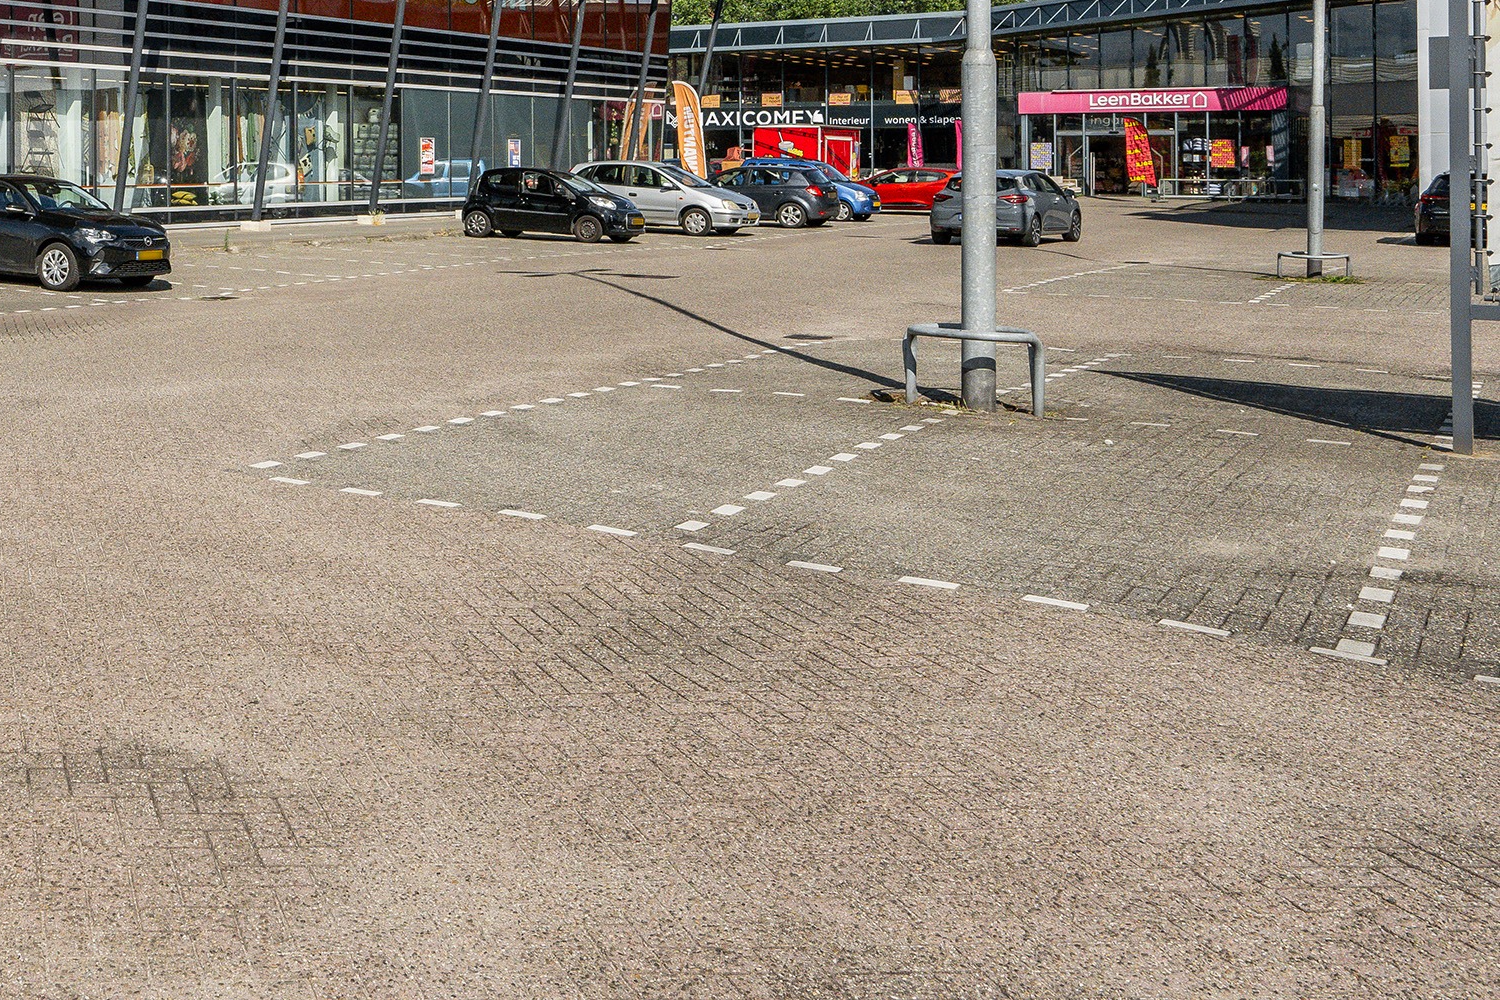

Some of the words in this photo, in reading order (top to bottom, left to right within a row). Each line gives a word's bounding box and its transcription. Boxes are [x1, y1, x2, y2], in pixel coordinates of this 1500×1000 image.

[1089, 93, 1191, 106] LeenBakker
[699, 110, 820, 127] AXICOMFY
[829, 116, 870, 125] Interieur
[919, 116, 928, 124] &
